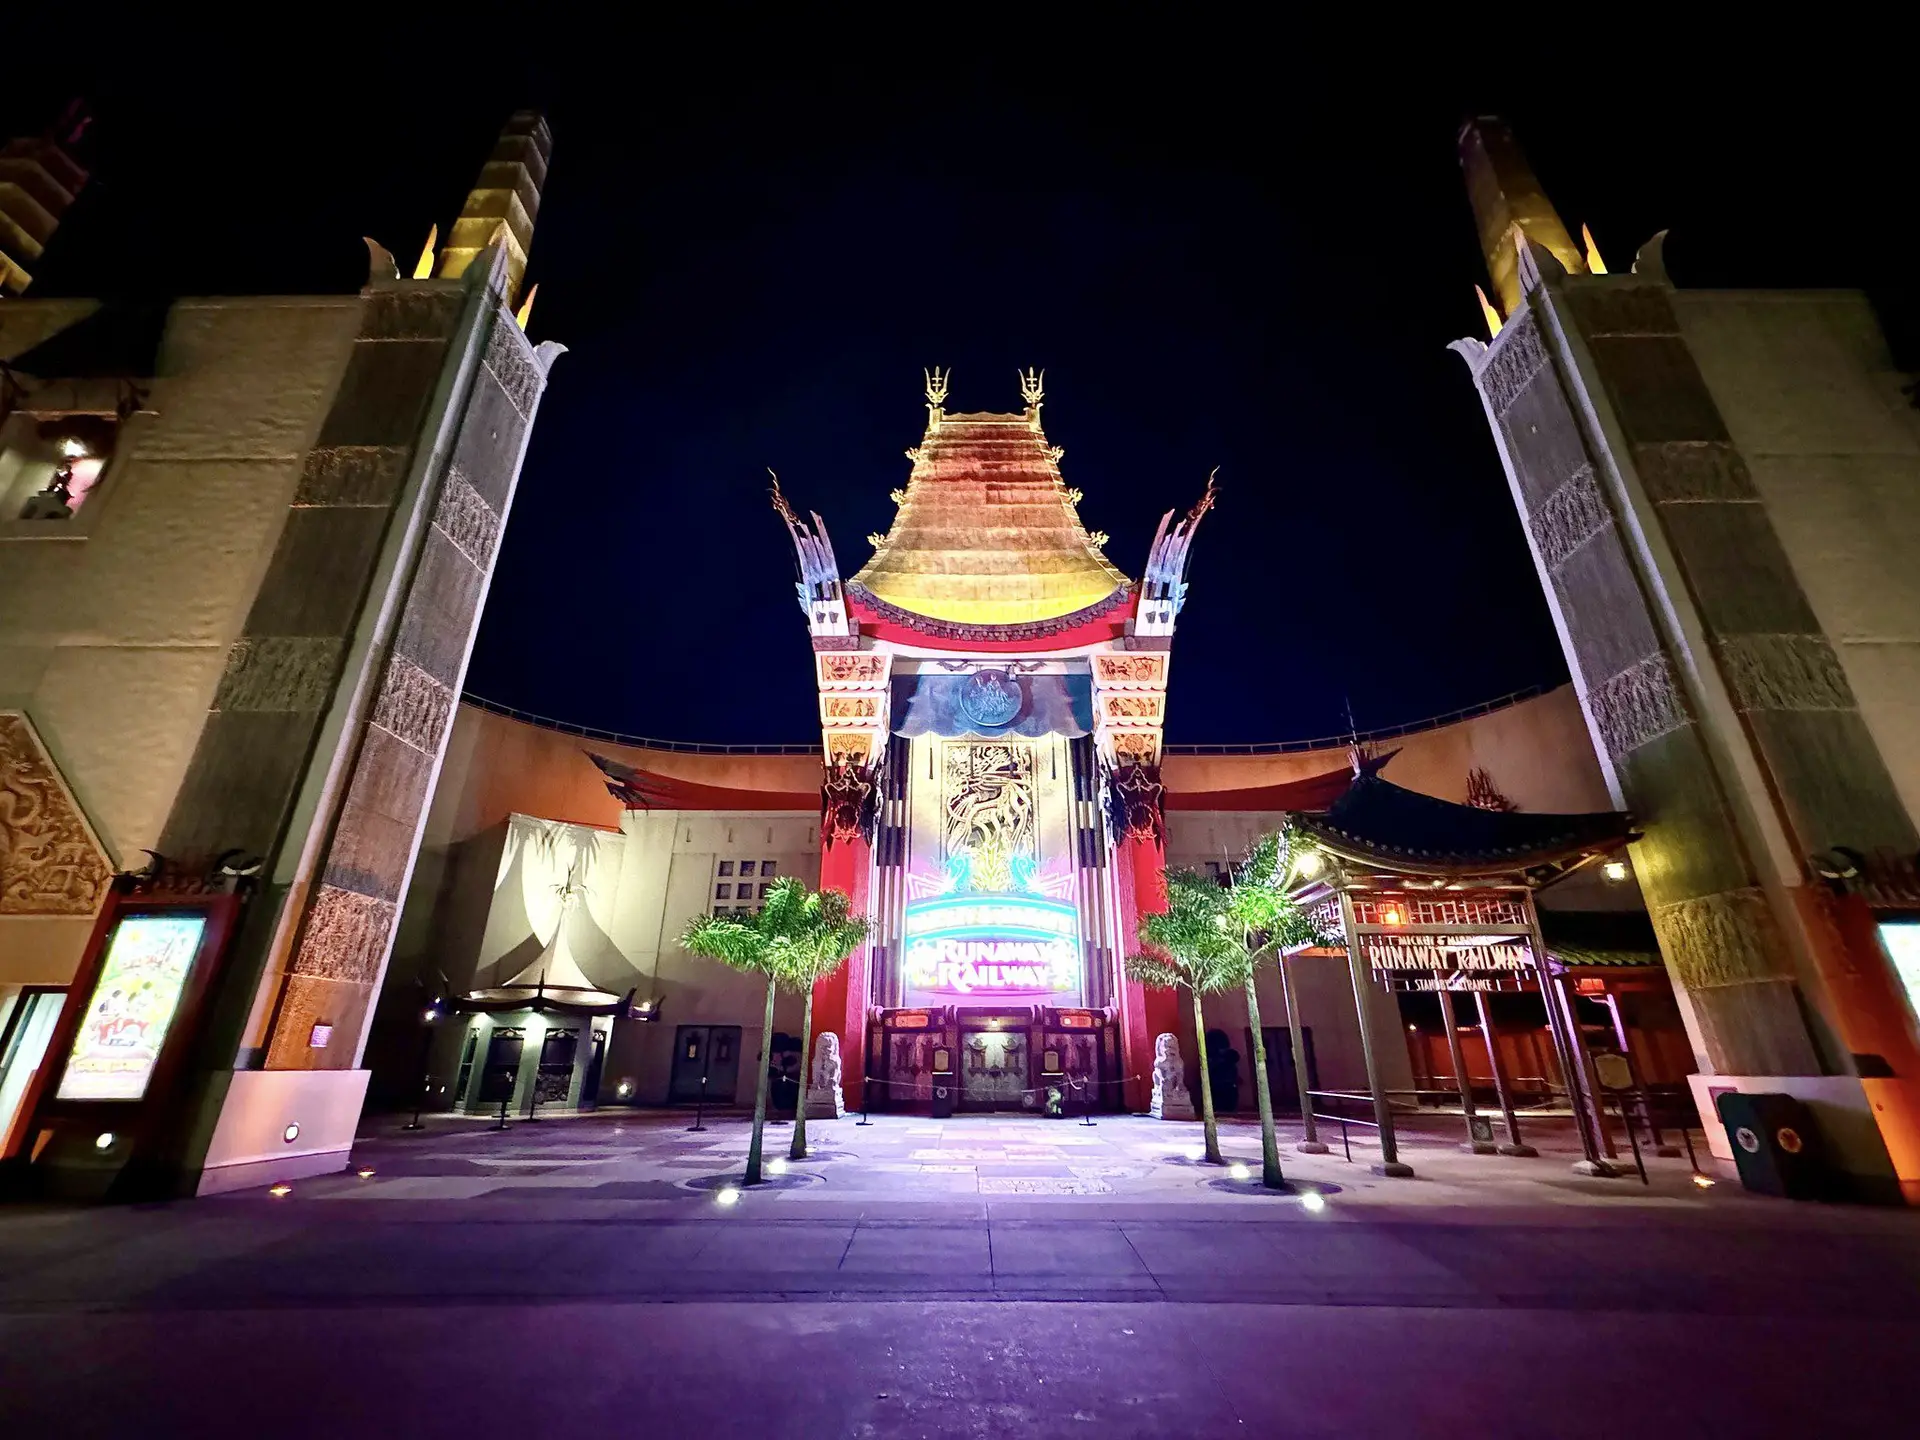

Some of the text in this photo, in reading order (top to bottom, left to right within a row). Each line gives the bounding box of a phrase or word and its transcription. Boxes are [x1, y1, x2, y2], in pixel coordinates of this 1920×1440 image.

[936, 939, 1053, 966] RUNAWAY
[1369, 946, 1527, 970] RUNAWAY RAILWAY
[936, 961, 1051, 993] RAILWAY
[1451, 979, 1492, 991] TRANCE
